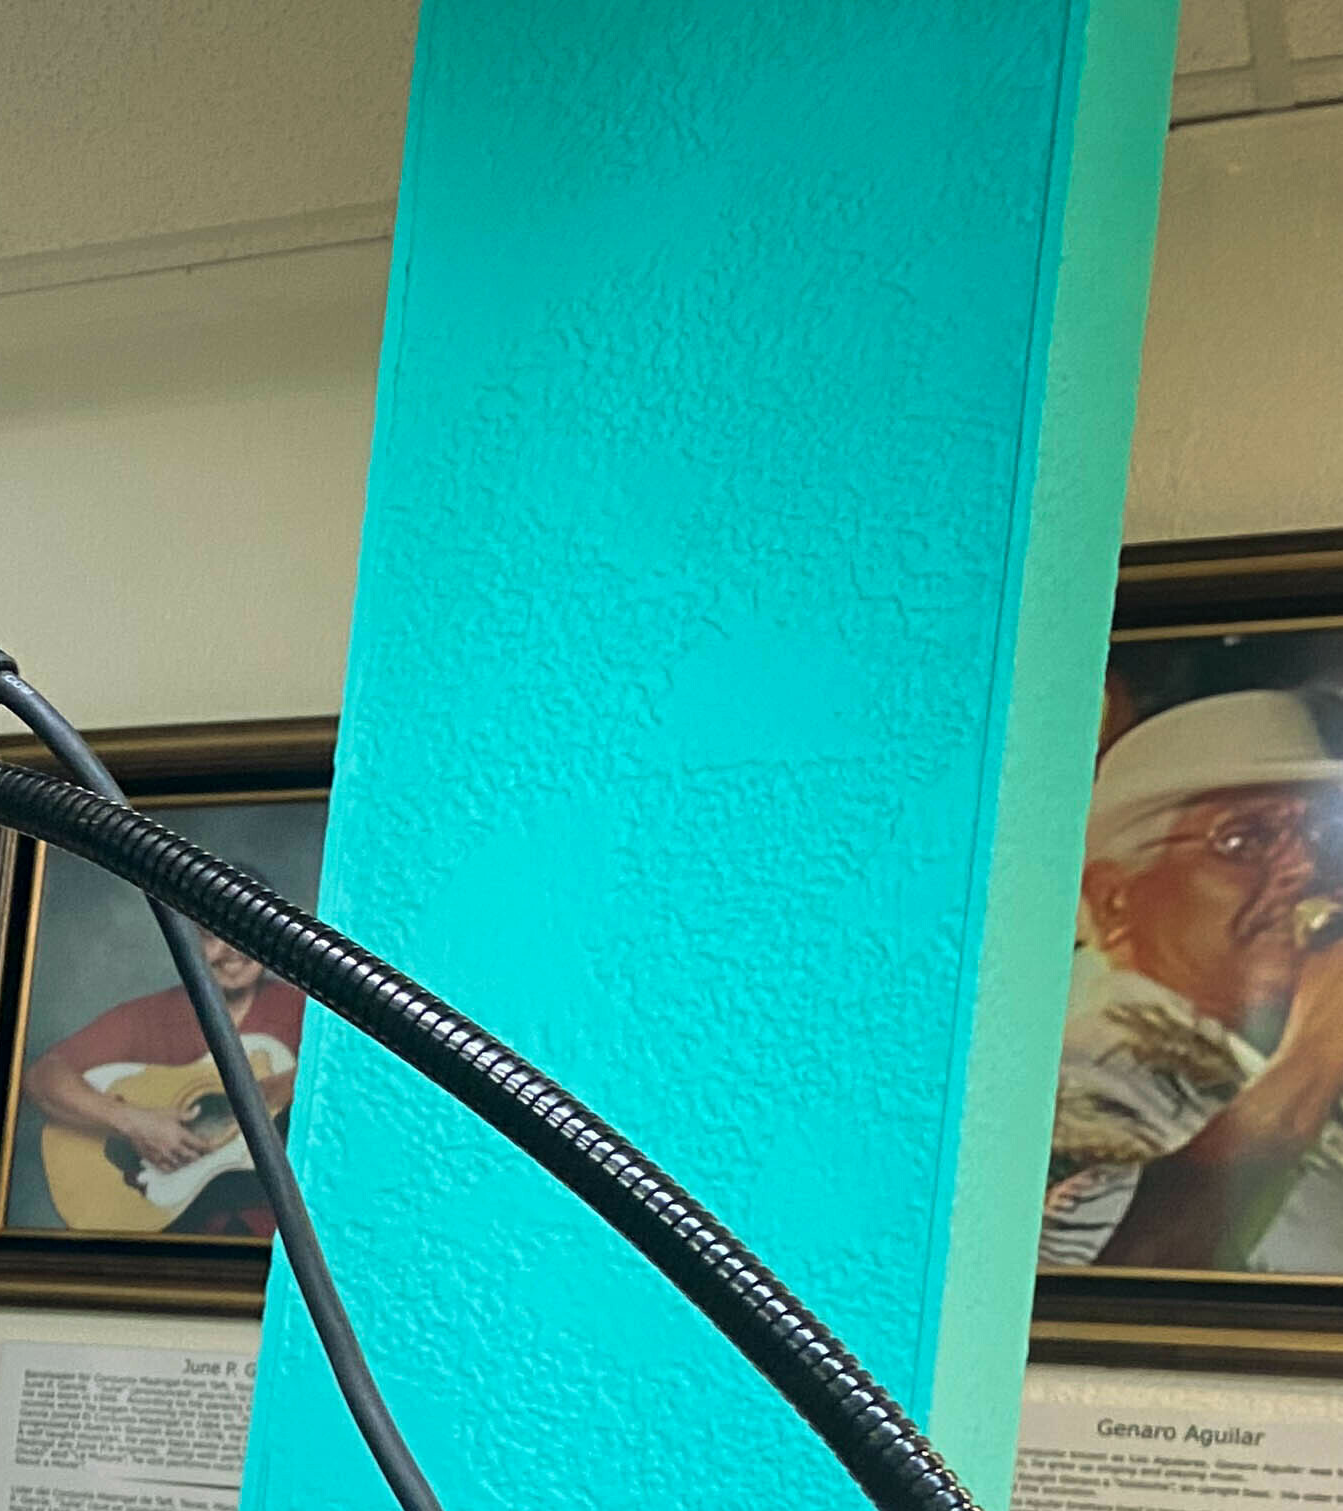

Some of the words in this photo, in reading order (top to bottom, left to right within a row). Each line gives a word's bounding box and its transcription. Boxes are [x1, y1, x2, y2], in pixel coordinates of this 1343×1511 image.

[182, 1358, 221, 1376] June
[1097, 1418, 1176, 1441] Genaro
[1184, 1424, 1266, 1448] Aguilar
